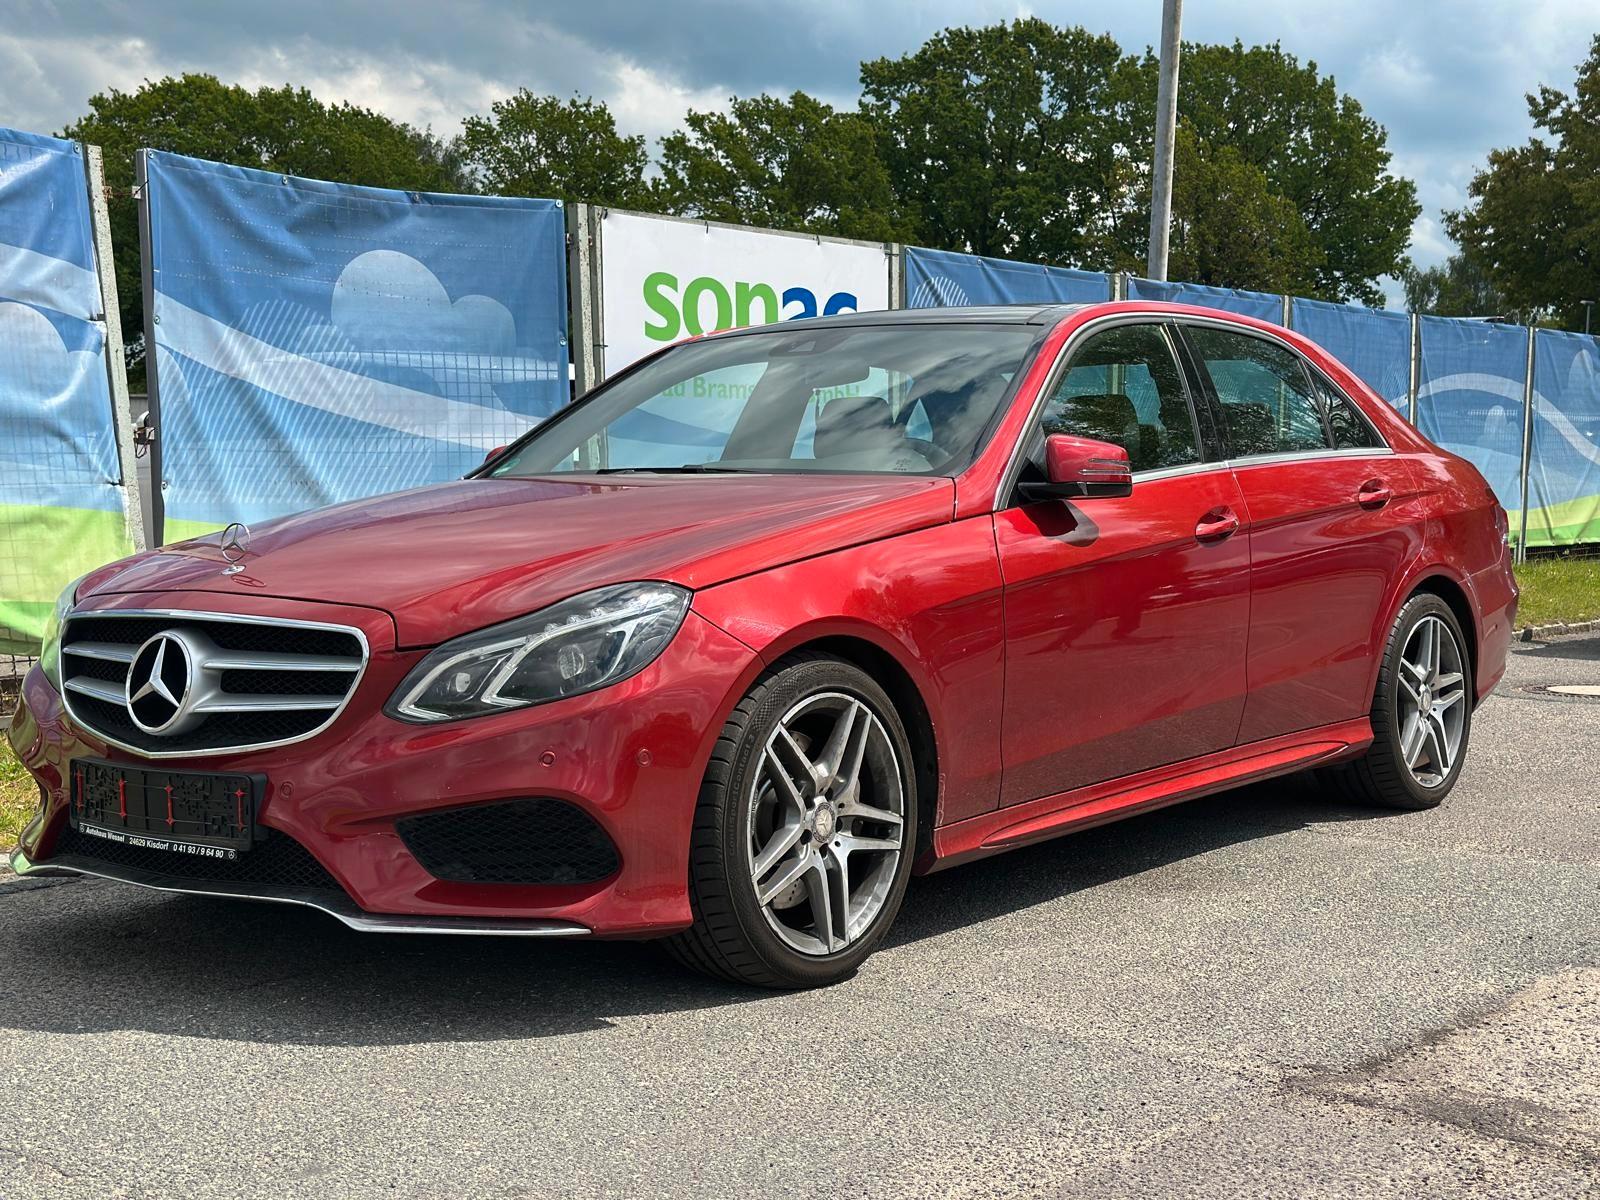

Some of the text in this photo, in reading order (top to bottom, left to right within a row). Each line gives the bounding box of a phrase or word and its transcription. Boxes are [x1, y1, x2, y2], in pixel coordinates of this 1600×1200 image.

[86, 826, 107, 838] Autohaus
[107, 832, 125, 842] Wessel
[129, 837, 146, 847] 24629
[147, 840, 169, 851] Kisdorf
